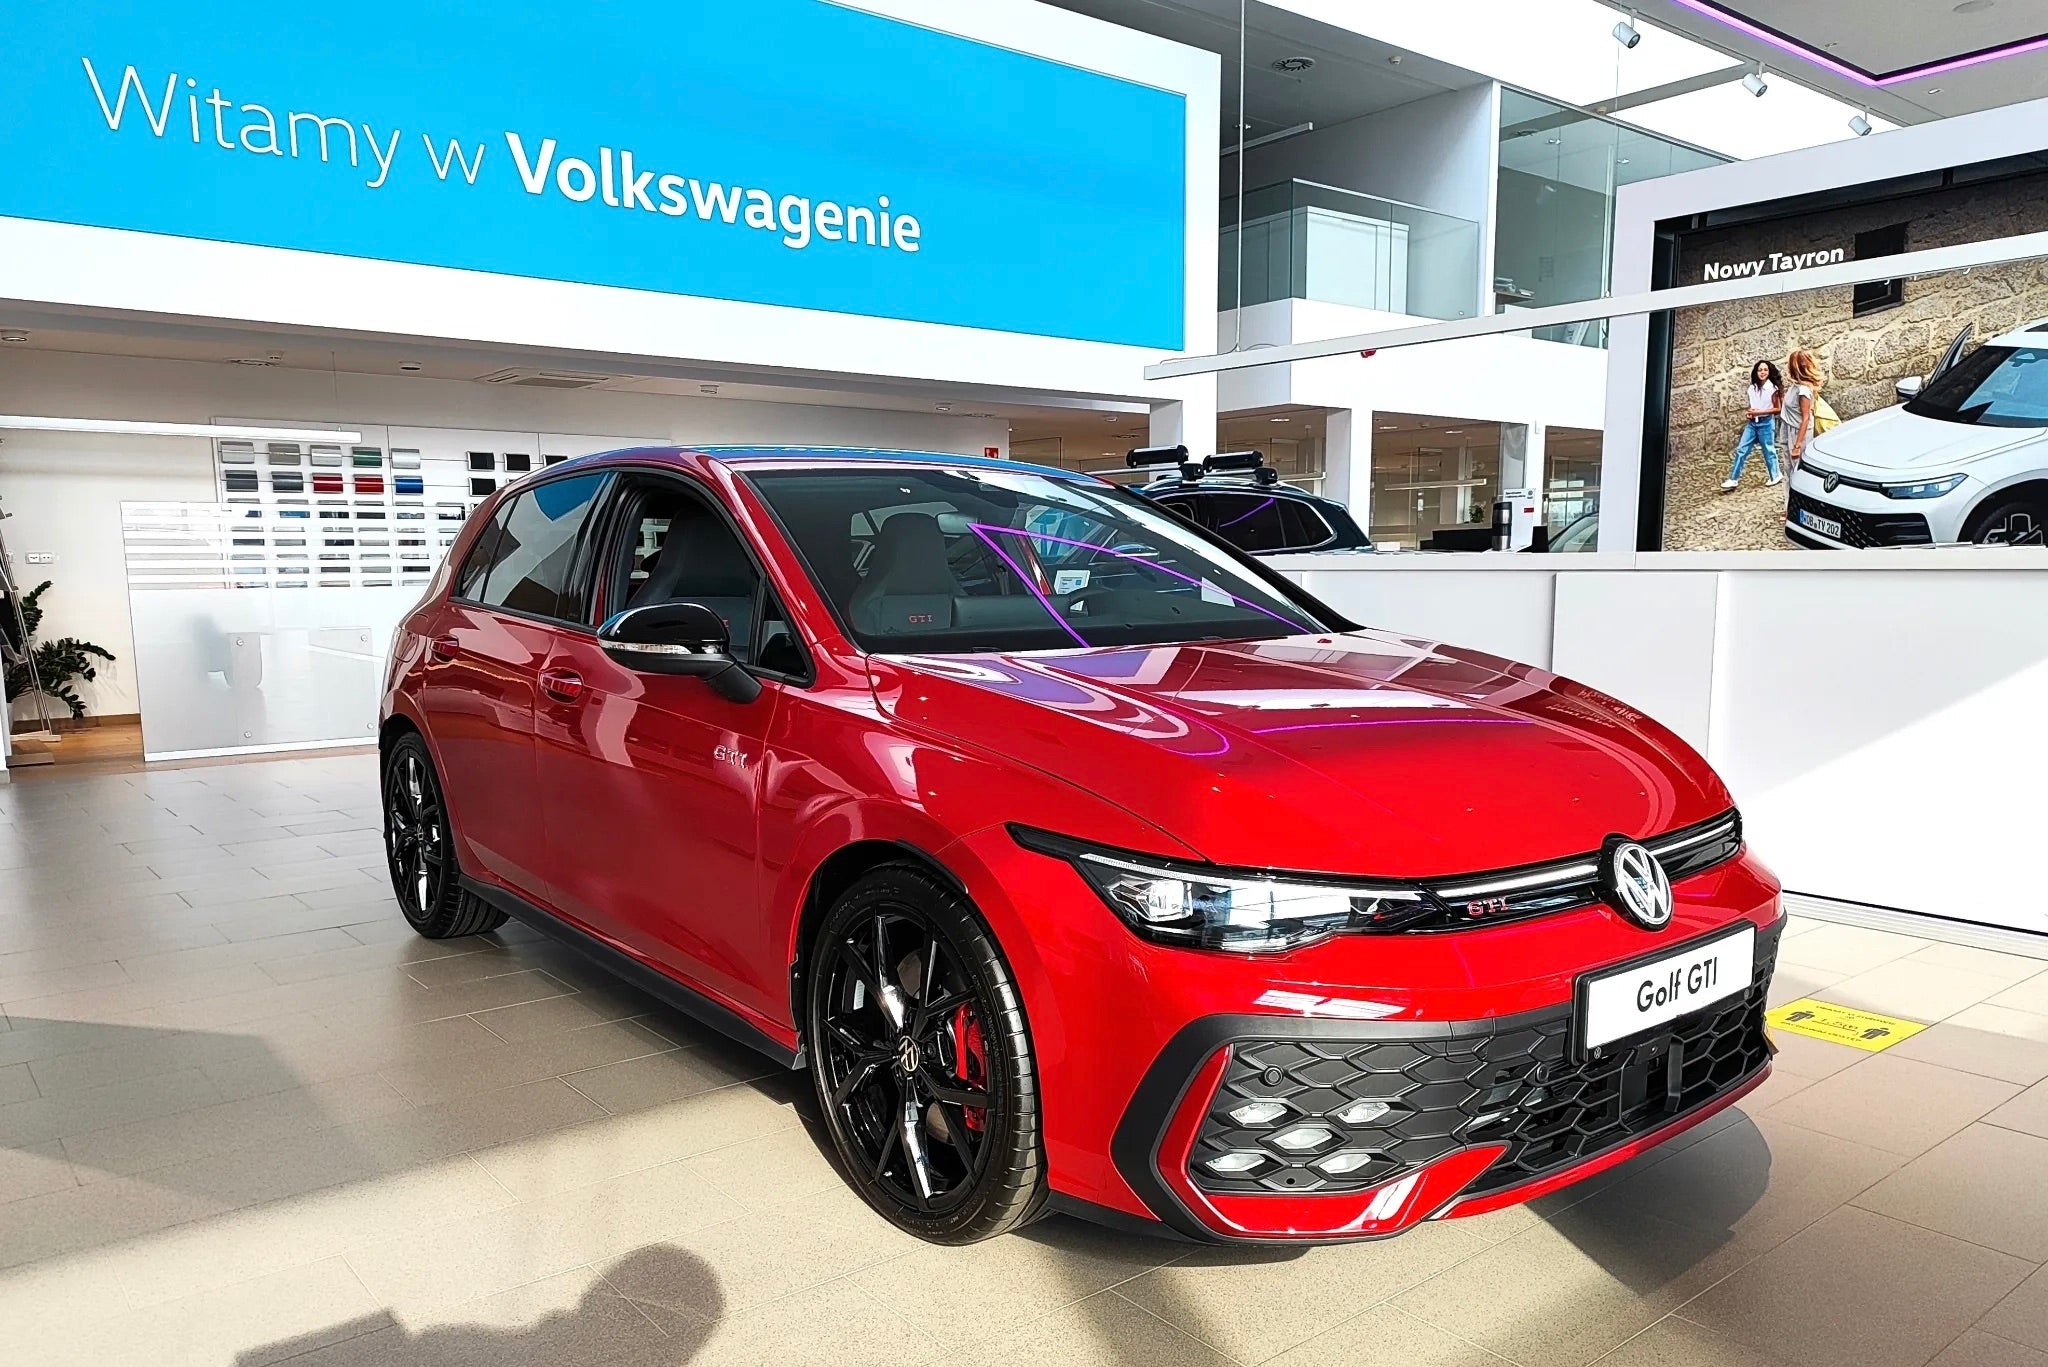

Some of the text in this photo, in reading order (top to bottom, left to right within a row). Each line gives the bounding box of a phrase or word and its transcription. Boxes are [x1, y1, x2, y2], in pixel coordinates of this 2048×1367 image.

[82, 57, 922, 253] Witamy w Volkswagenie
[1703, 247, 1845, 281] Nowy Tayron
[908, 614, 933, 623] GTI
[713, 744, 748, 769] GTI
[1467, 897, 1508, 916] GTI
[1636, 956, 1718, 1013] Golf GTI
